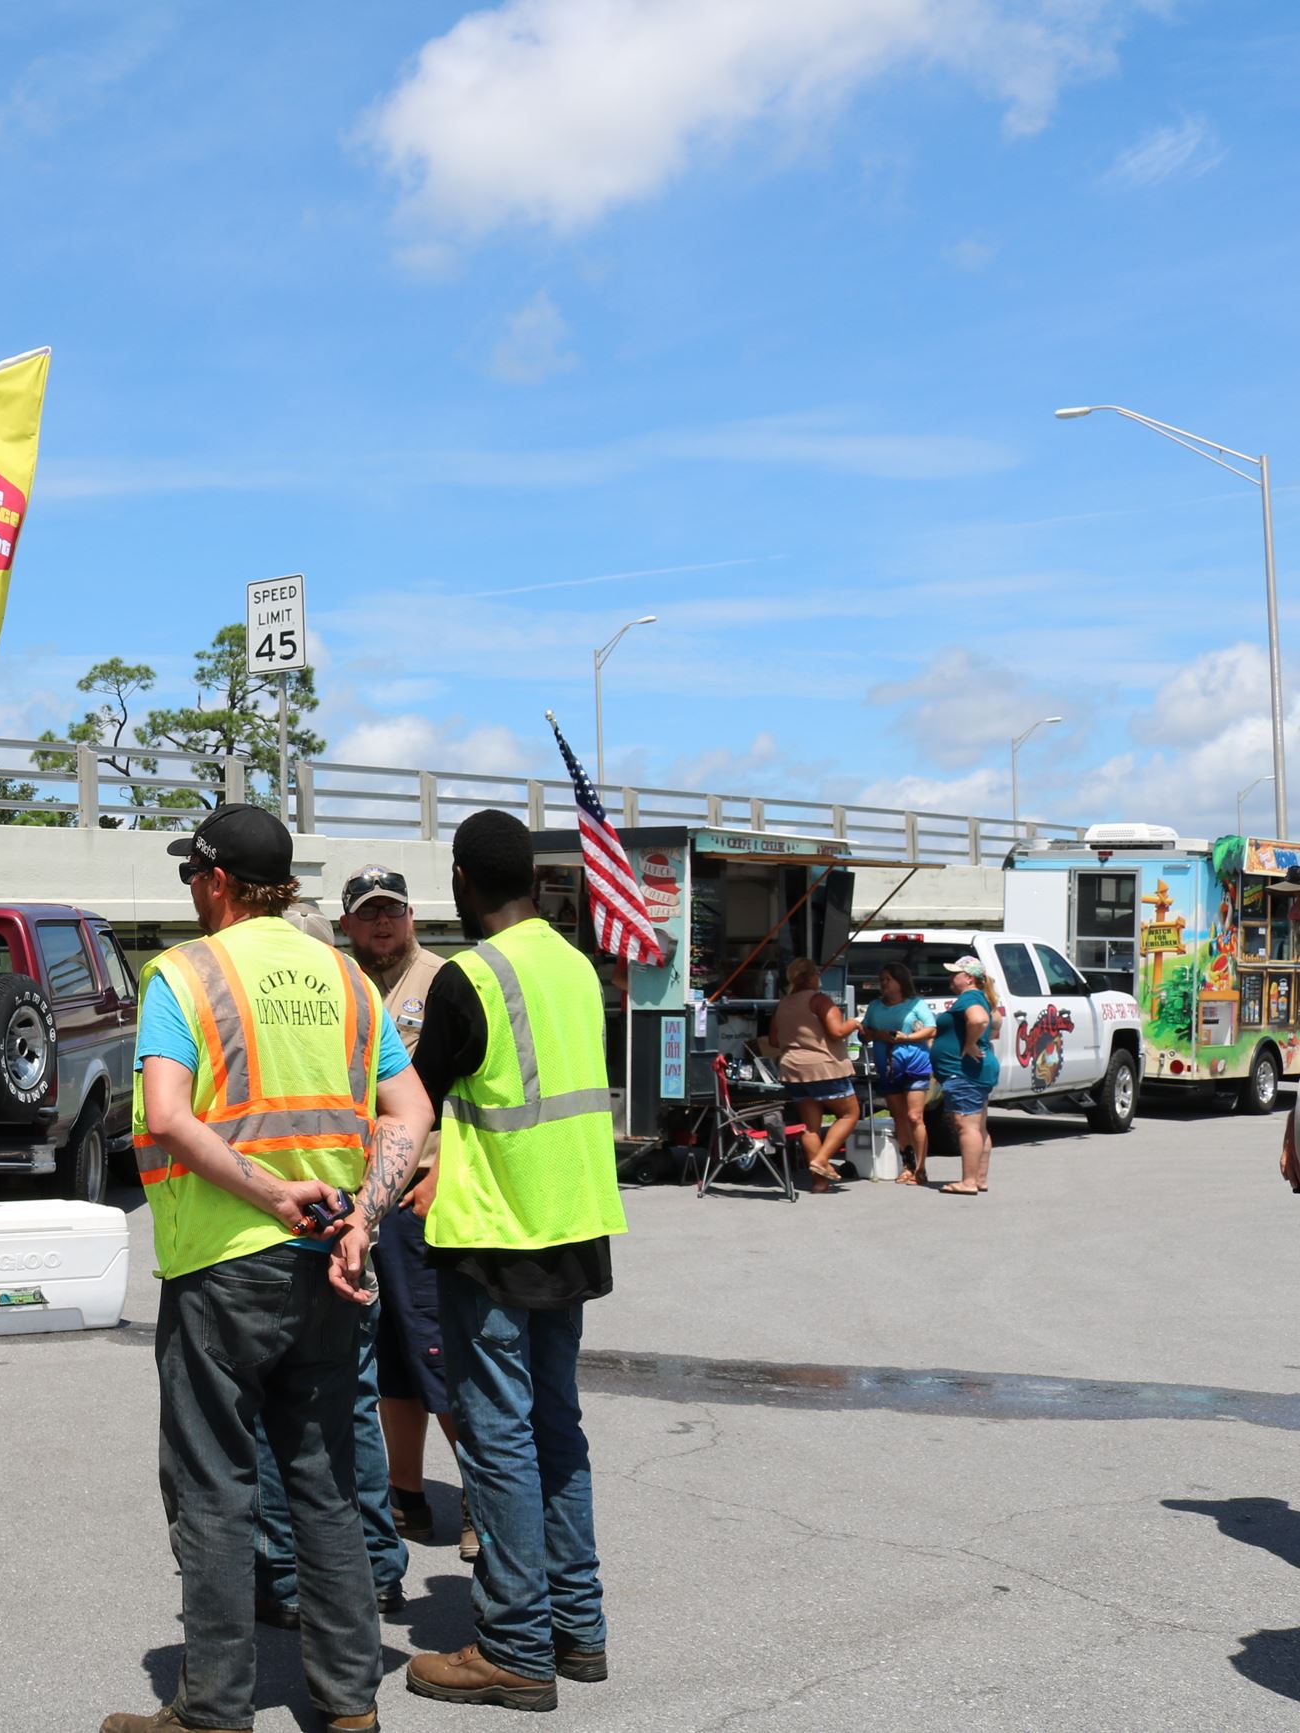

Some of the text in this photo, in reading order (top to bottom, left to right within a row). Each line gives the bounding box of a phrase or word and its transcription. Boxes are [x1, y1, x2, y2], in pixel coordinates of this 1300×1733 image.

[253, 585, 297, 604] SPEED
[258, 608, 293, 626] LIMIT
[255, 630, 298, 662] 45
[259, 969, 331, 996] CITY OF
[15, 991, 56, 1043] LAREDO
